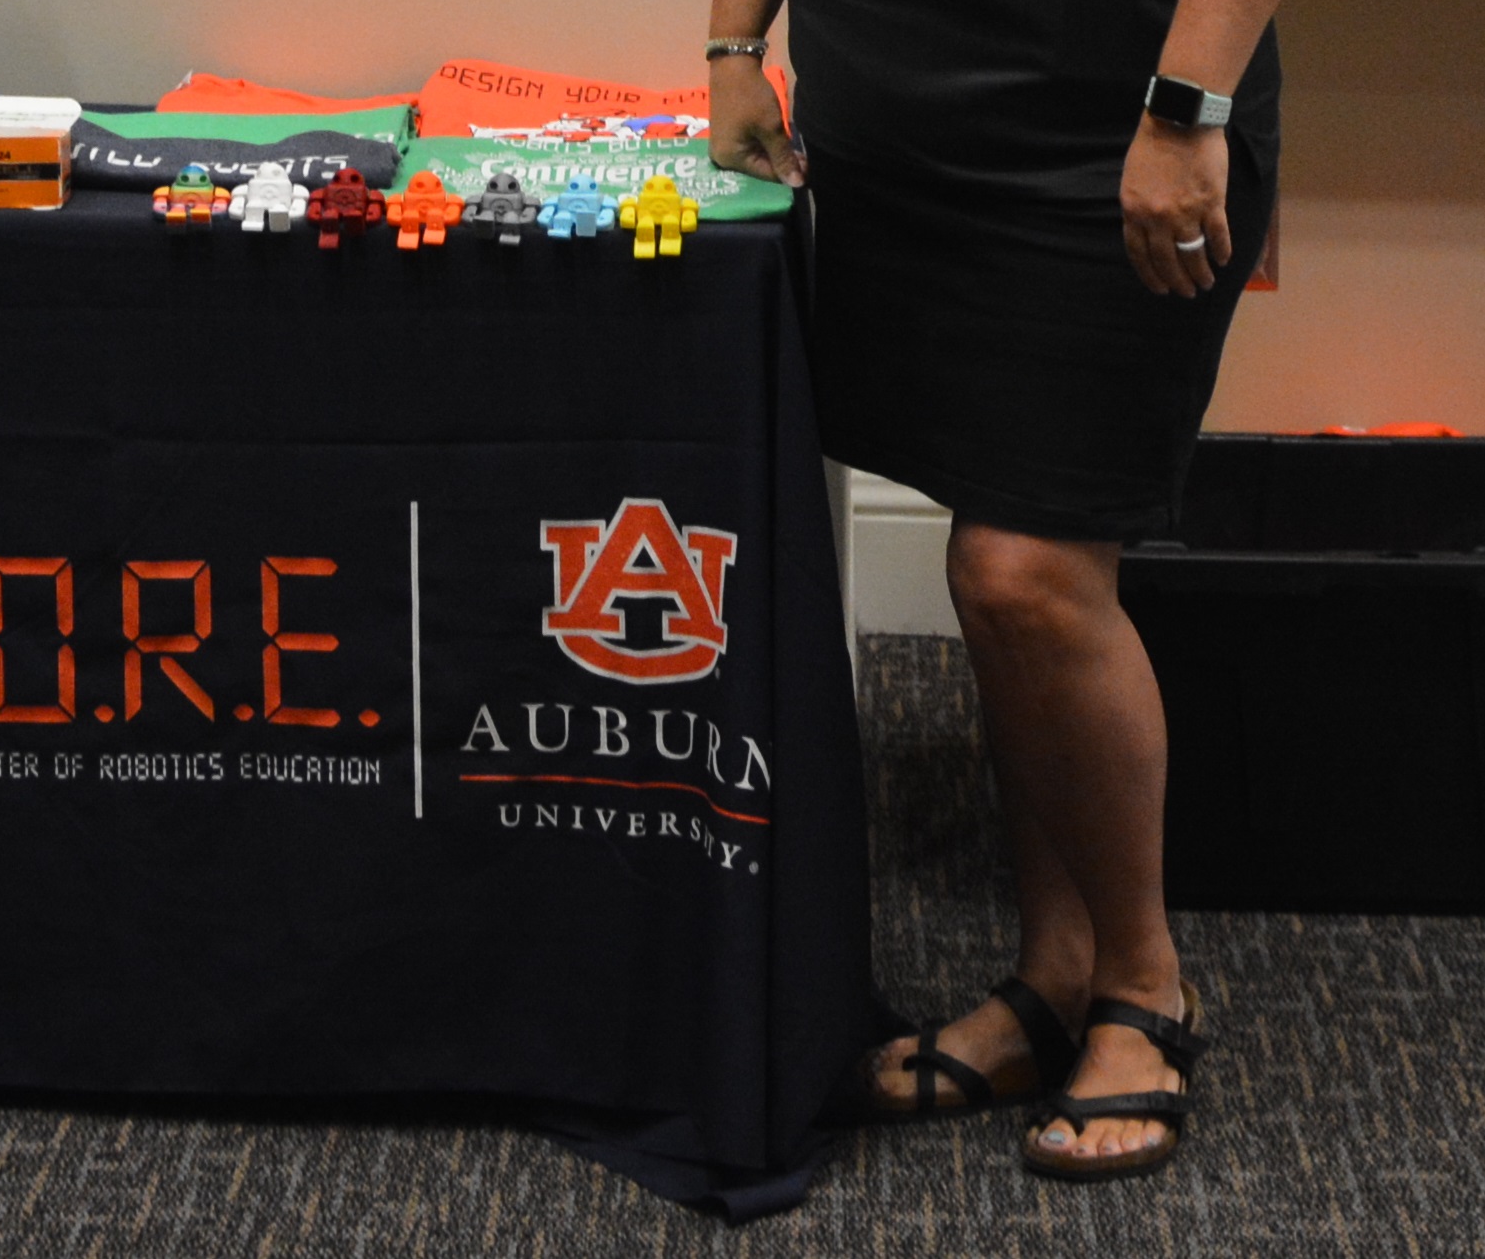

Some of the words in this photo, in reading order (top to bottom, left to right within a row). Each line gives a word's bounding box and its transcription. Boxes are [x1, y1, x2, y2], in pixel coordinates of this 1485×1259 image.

[440, 65, 544, 99] DESIGN
[460, 703, 771, 792] AUBURN
[54, 753, 84, 780] OF
[99, 753, 224, 782] ROBOTICS
[240, 753, 381, 785] EDUCATION
